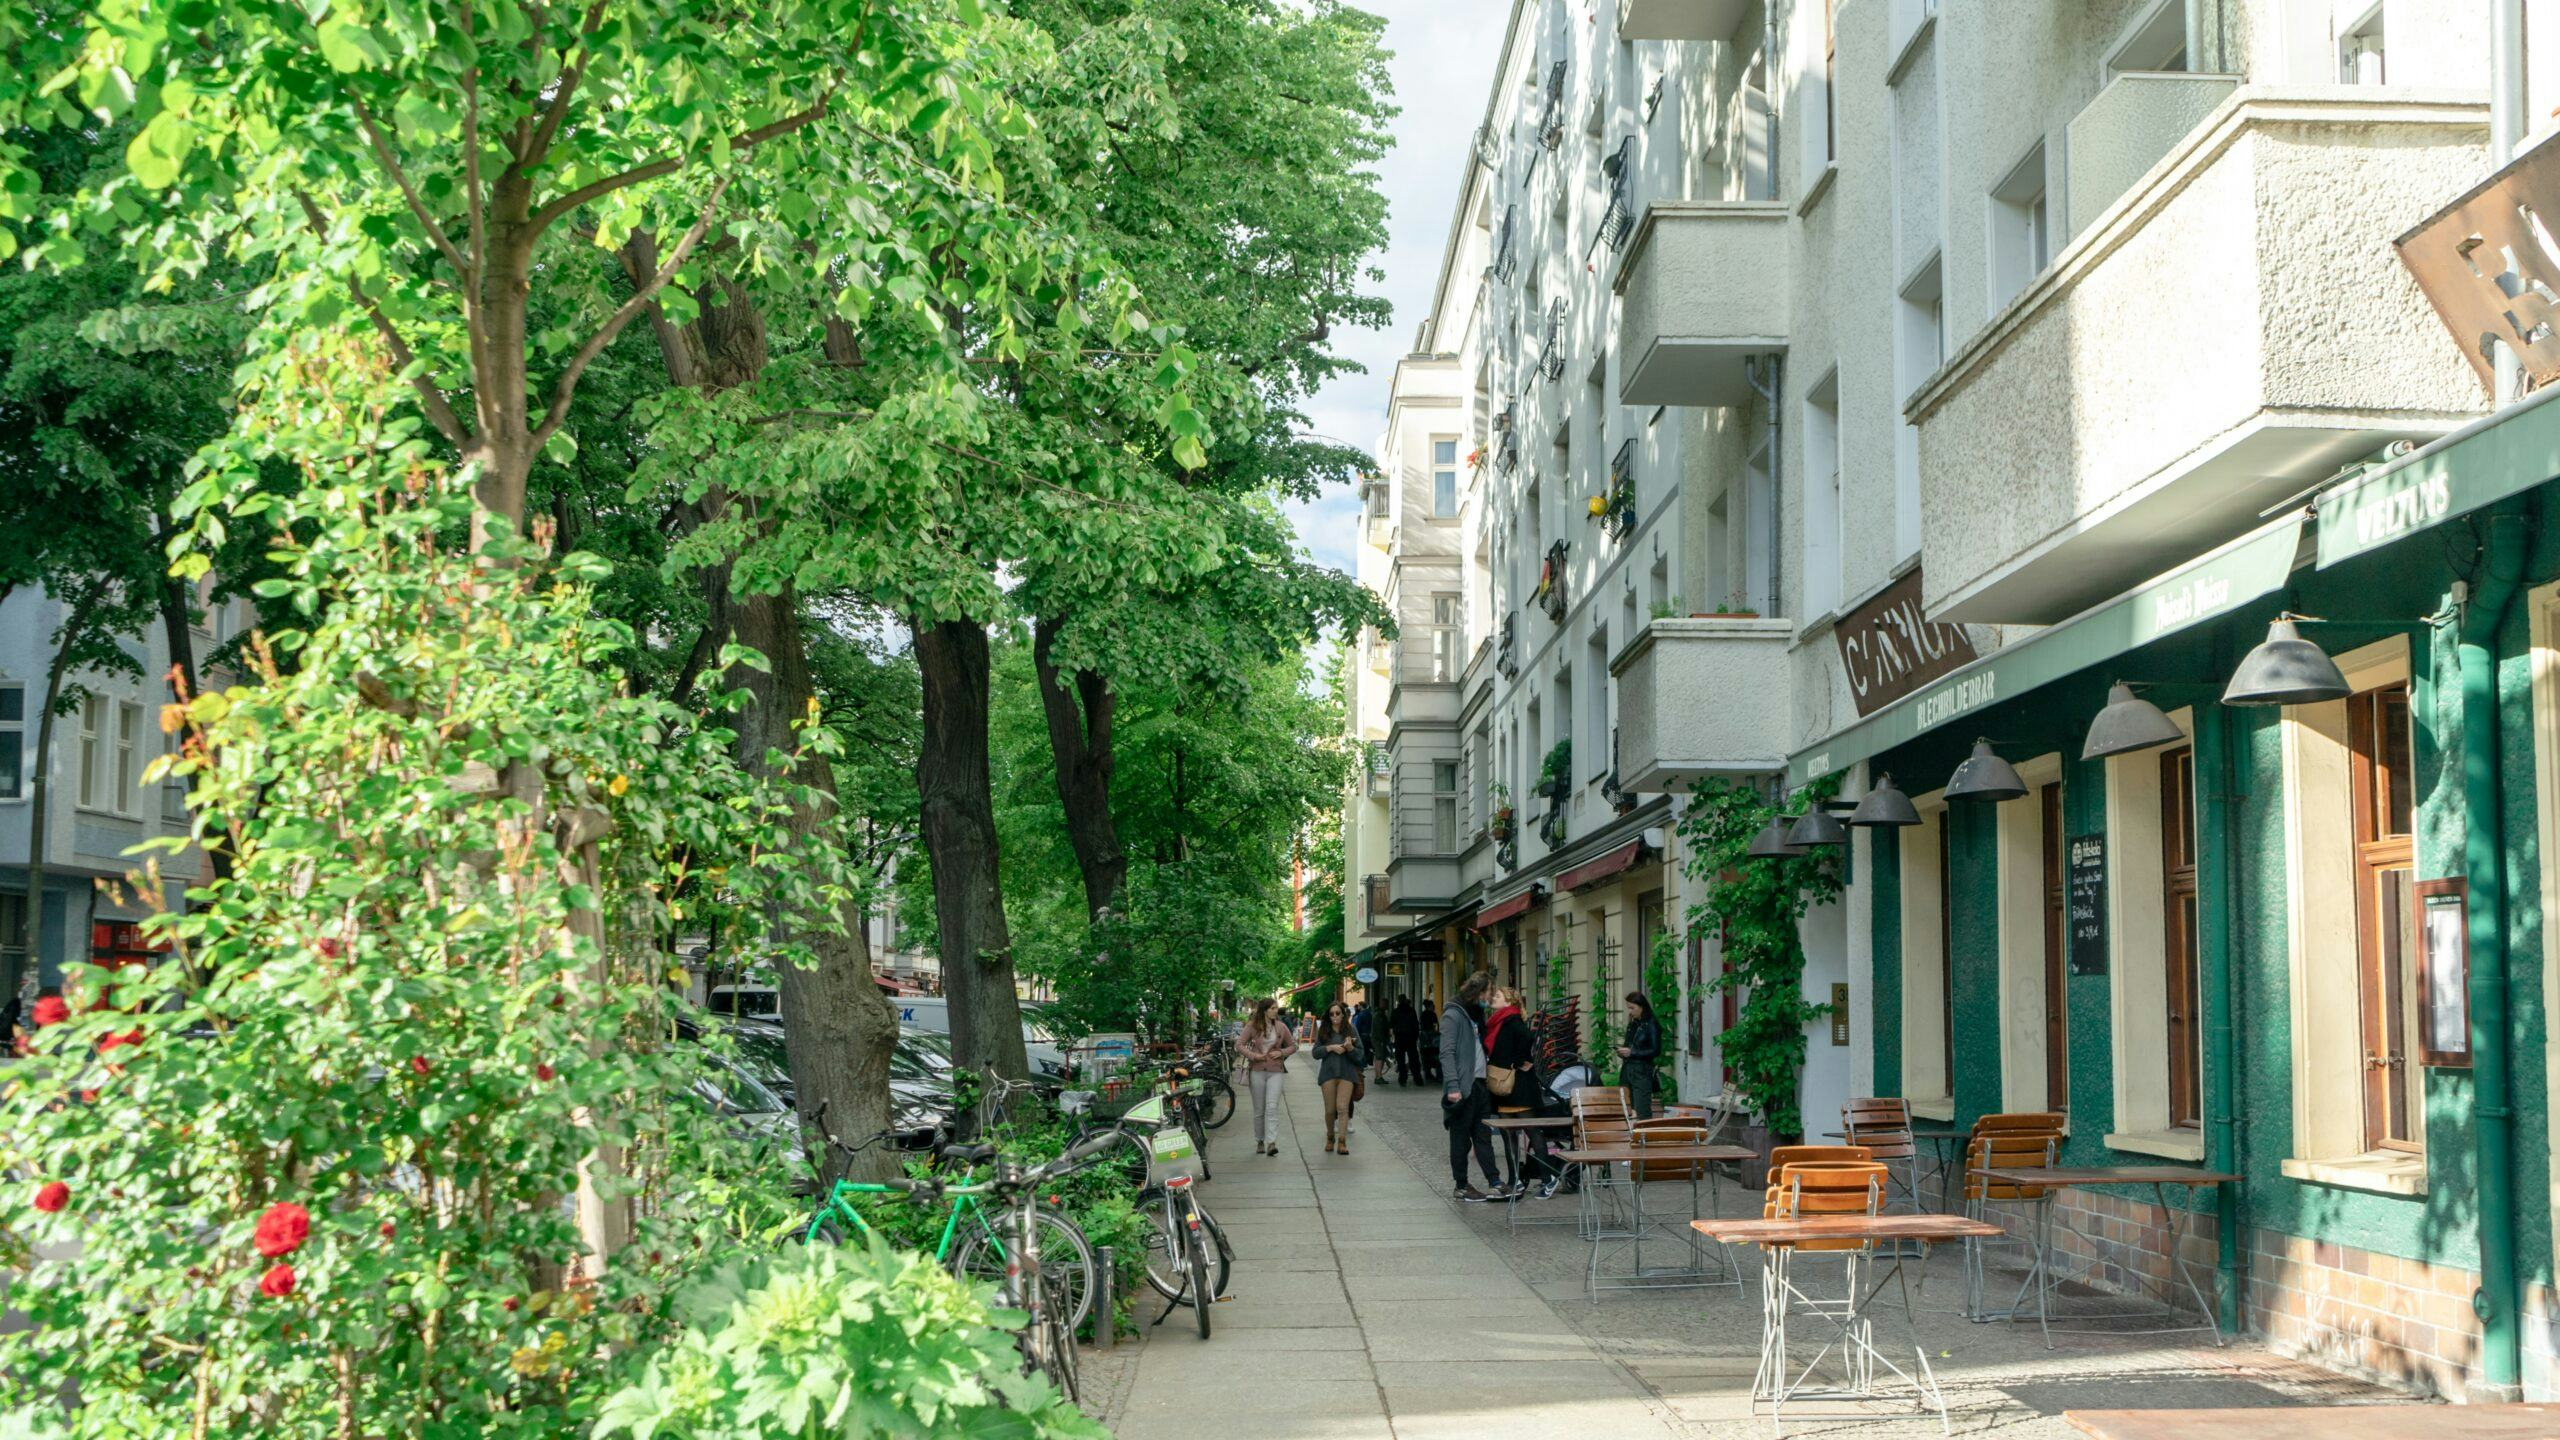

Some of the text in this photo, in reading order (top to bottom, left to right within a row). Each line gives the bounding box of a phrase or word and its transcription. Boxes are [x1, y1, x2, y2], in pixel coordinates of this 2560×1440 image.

[2356, 472, 2450, 545] VELTINS
[1917, 670, 1995, 730] BLECHBILDERBAR
[1807, 752, 1829, 778] VELTINS
